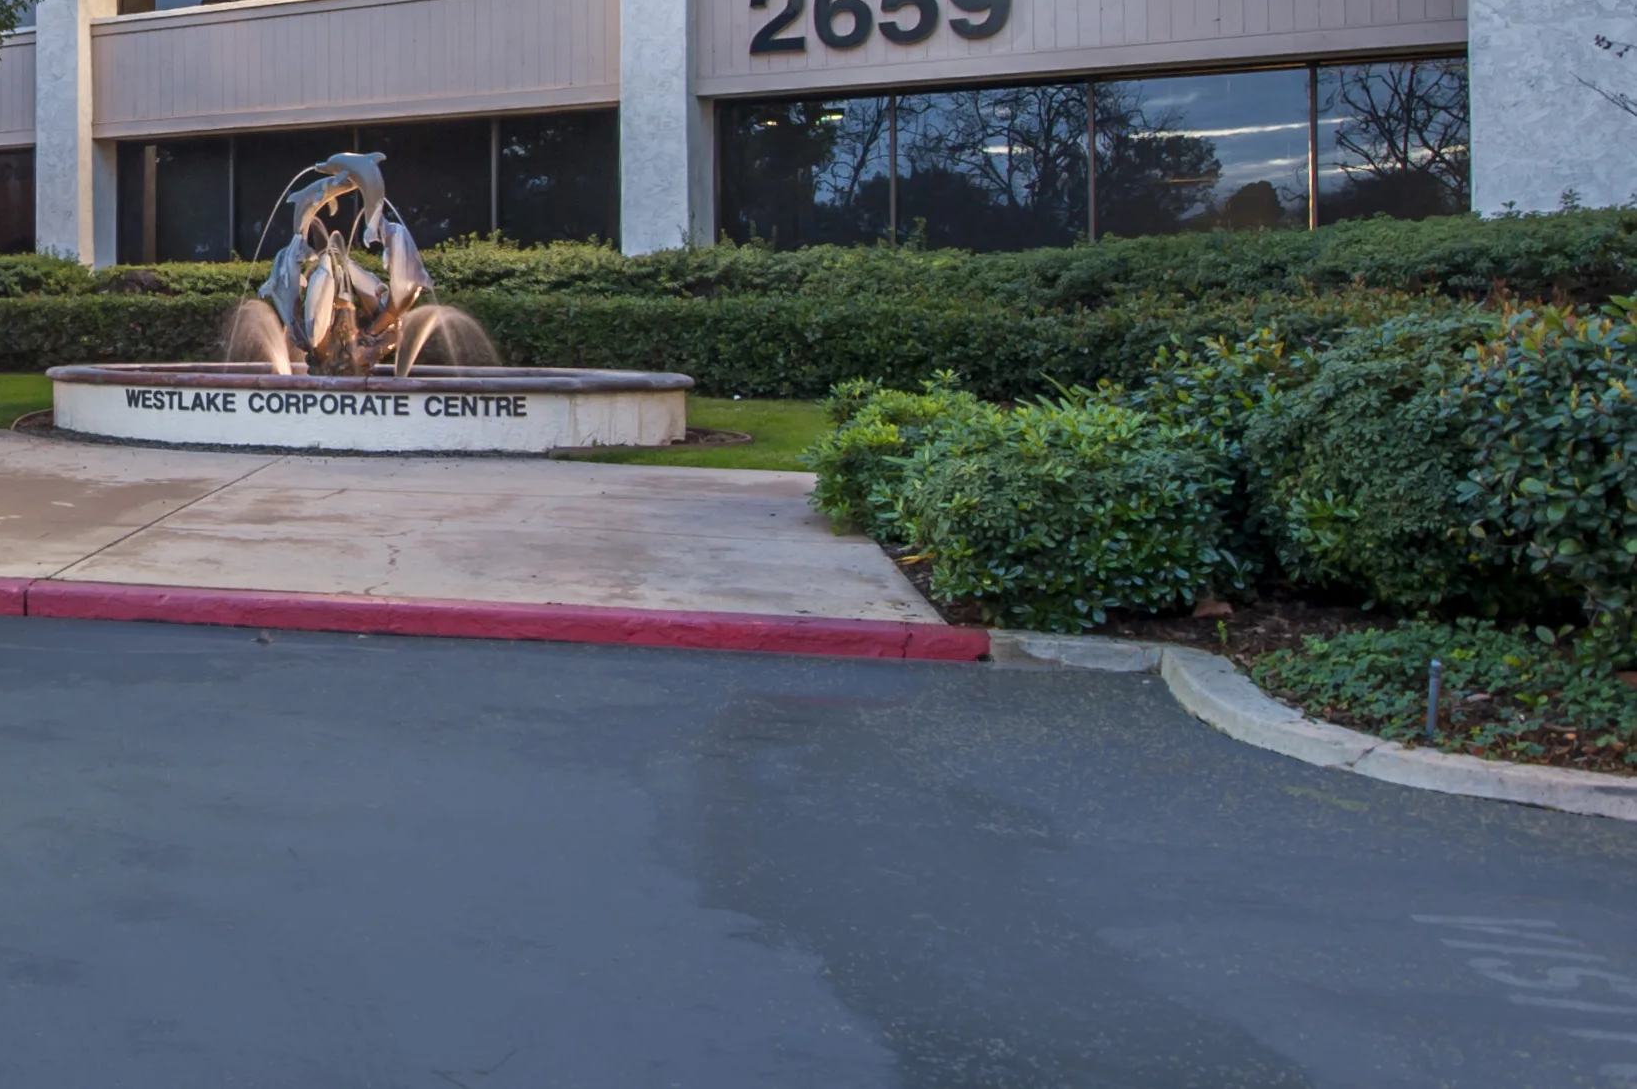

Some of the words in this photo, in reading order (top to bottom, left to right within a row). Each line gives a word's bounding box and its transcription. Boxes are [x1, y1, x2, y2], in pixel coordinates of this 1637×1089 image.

[125, 389, 236, 413] WESTLAKE
[248, 392, 410, 417] CORPORATE
[424, 395, 527, 417] CENTRE
